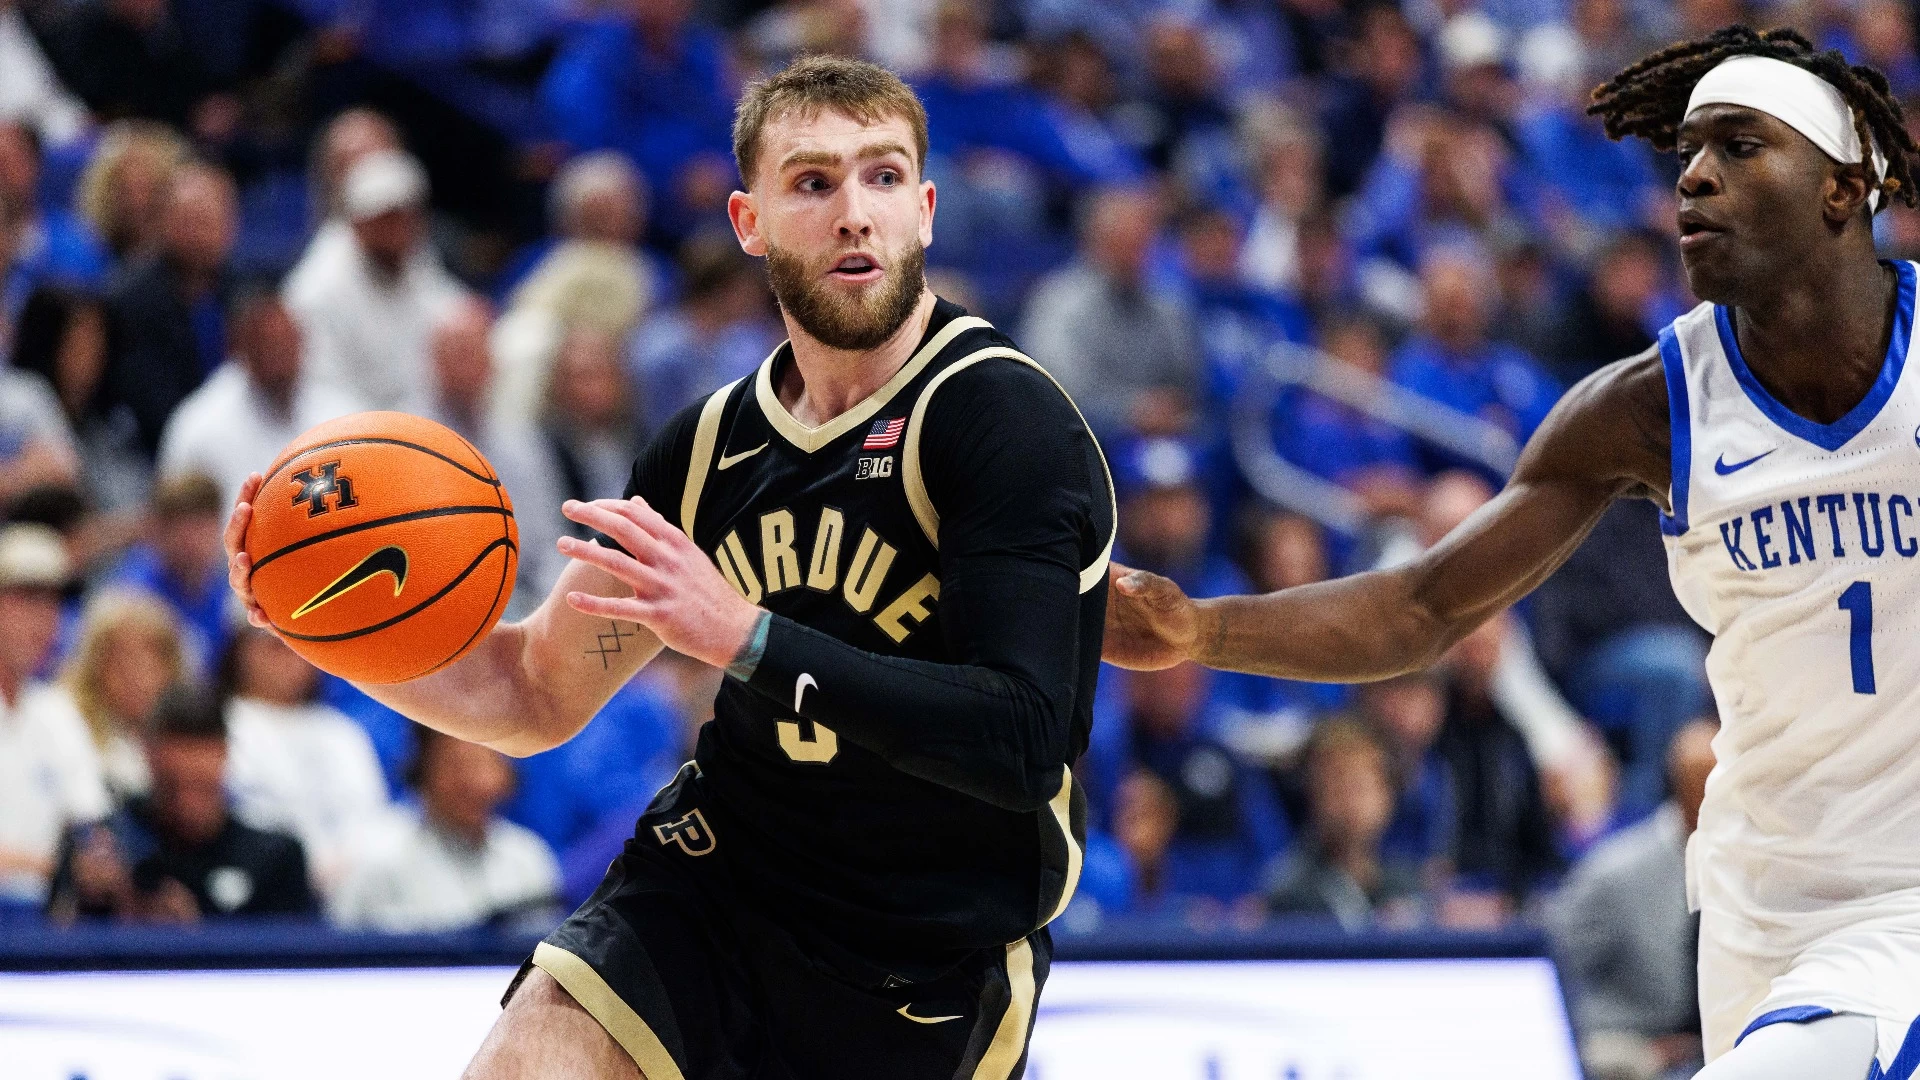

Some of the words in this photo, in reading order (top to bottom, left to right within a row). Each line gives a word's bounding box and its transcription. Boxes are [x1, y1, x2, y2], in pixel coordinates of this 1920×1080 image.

[856, 455, 894, 480] BIG
[715, 505, 940, 646] URDUE
[1719, 492, 1920, 572] KENTUC
[1837, 580, 1876, 695] 1
